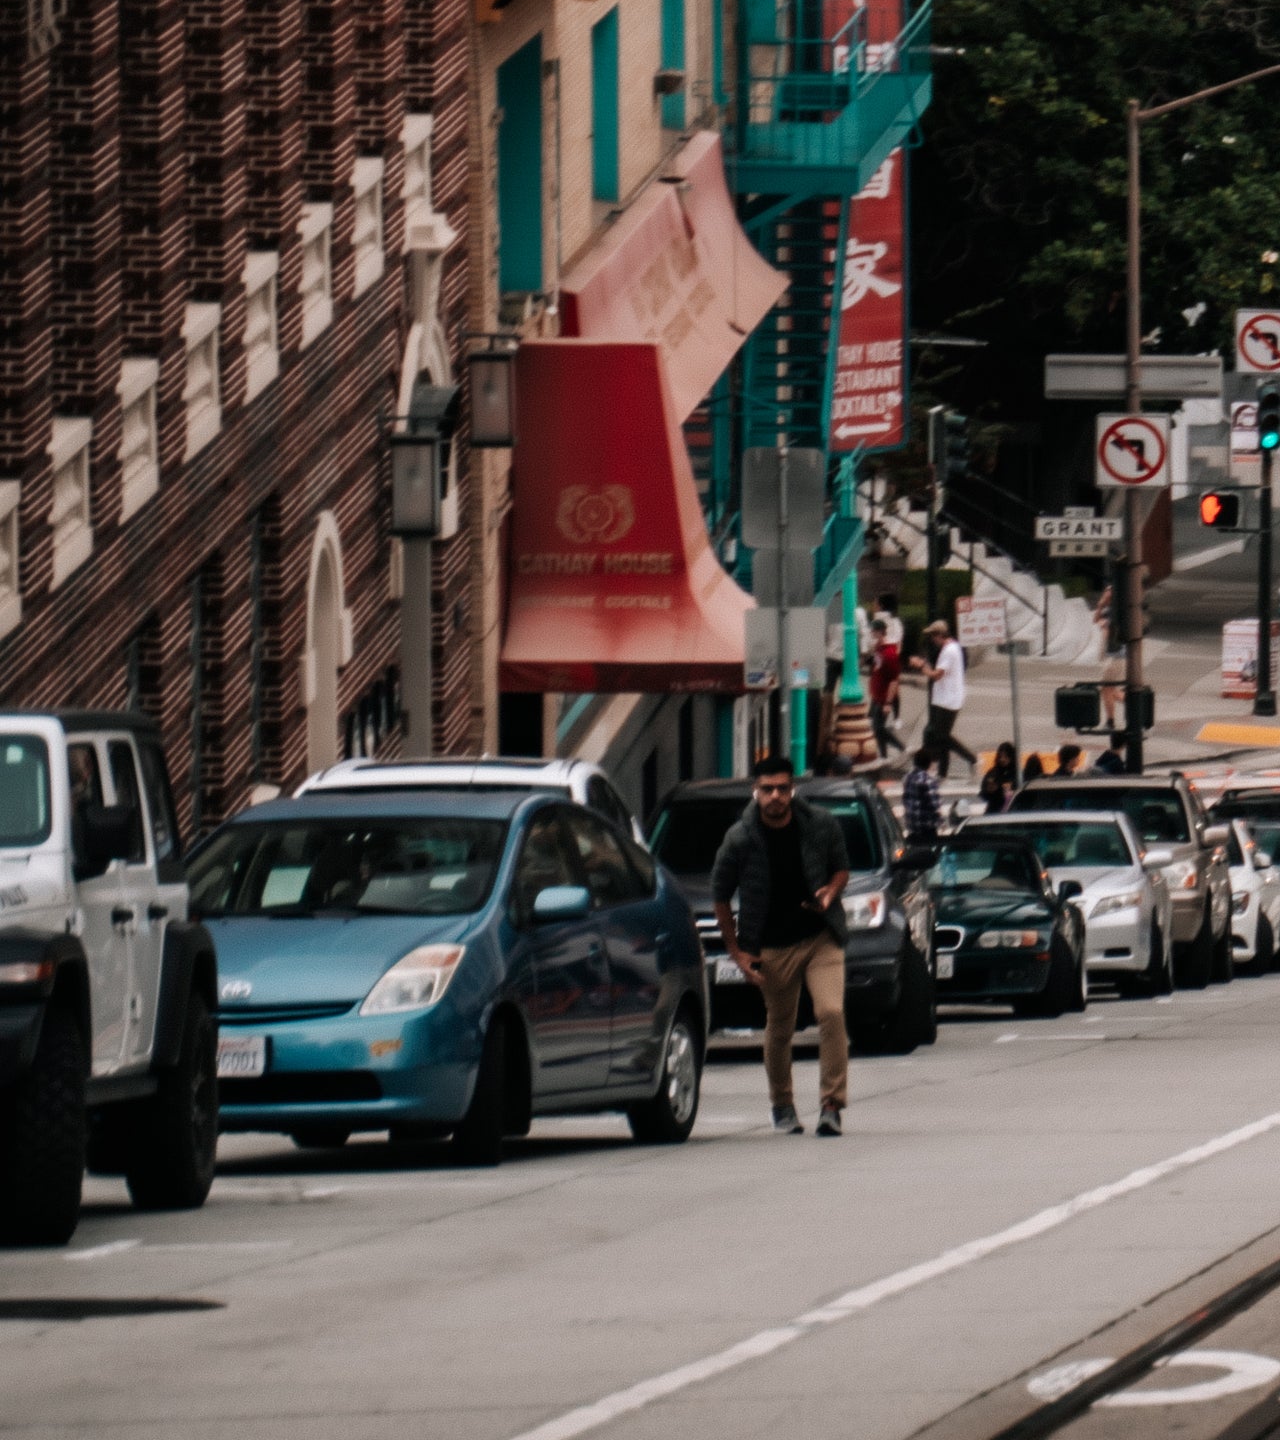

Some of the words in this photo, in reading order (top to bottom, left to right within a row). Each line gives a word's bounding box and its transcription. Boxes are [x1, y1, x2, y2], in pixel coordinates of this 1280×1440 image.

[1042, 521, 1116, 536] GRANT
[516, 552, 597, 574] CATHAY
[603, 551, 673, 574] HOUSE
